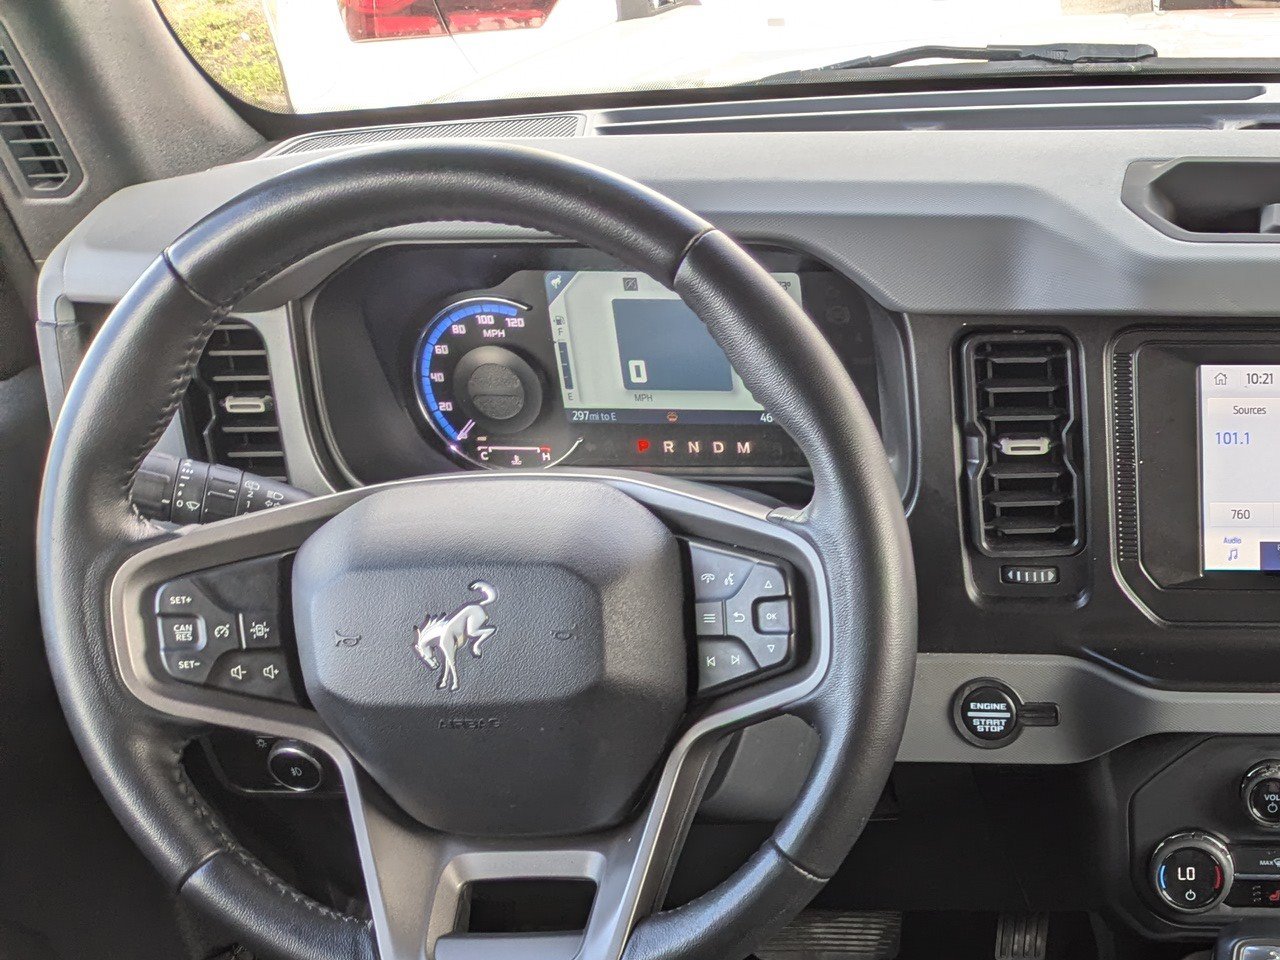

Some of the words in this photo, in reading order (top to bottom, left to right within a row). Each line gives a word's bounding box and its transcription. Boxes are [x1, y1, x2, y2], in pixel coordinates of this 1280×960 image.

[475, 315, 495, 325] 100
[506, 318, 525, 328] 120
[452, 325, 466, 335] 80
[483, 329, 505, 338] MPH
[435, 345, 449, 355] 60
[430, 372, 445, 383] 40
[1246, 373, 1274, 386] 10:21
[567, 392, 573, 401] E
[634, 393, 654, 402] MPH
[438, 402, 453, 412] 20
[1233, 405, 1267, 415] Sources
[572, 411, 590, 421] 297
[1215, 432, 1251, 445] 101.1
[637, 439, 650, 453] P
[663, 441, 675, 453] R
[688, 441, 701, 453] N
[712, 441, 724, 453] D
[737, 441, 751, 454] M
[481, 452, 489, 460] C
[542, 453, 551, 461] H
[1231, 509, 1251, 520] 760
[1223, 537, 1242, 545] Audio
[170, 596, 192, 605] SET+
[173, 624, 193, 633] CAN
[176, 633, 193, 642] RES
[970, 702, 1007, 710] ENGINE
